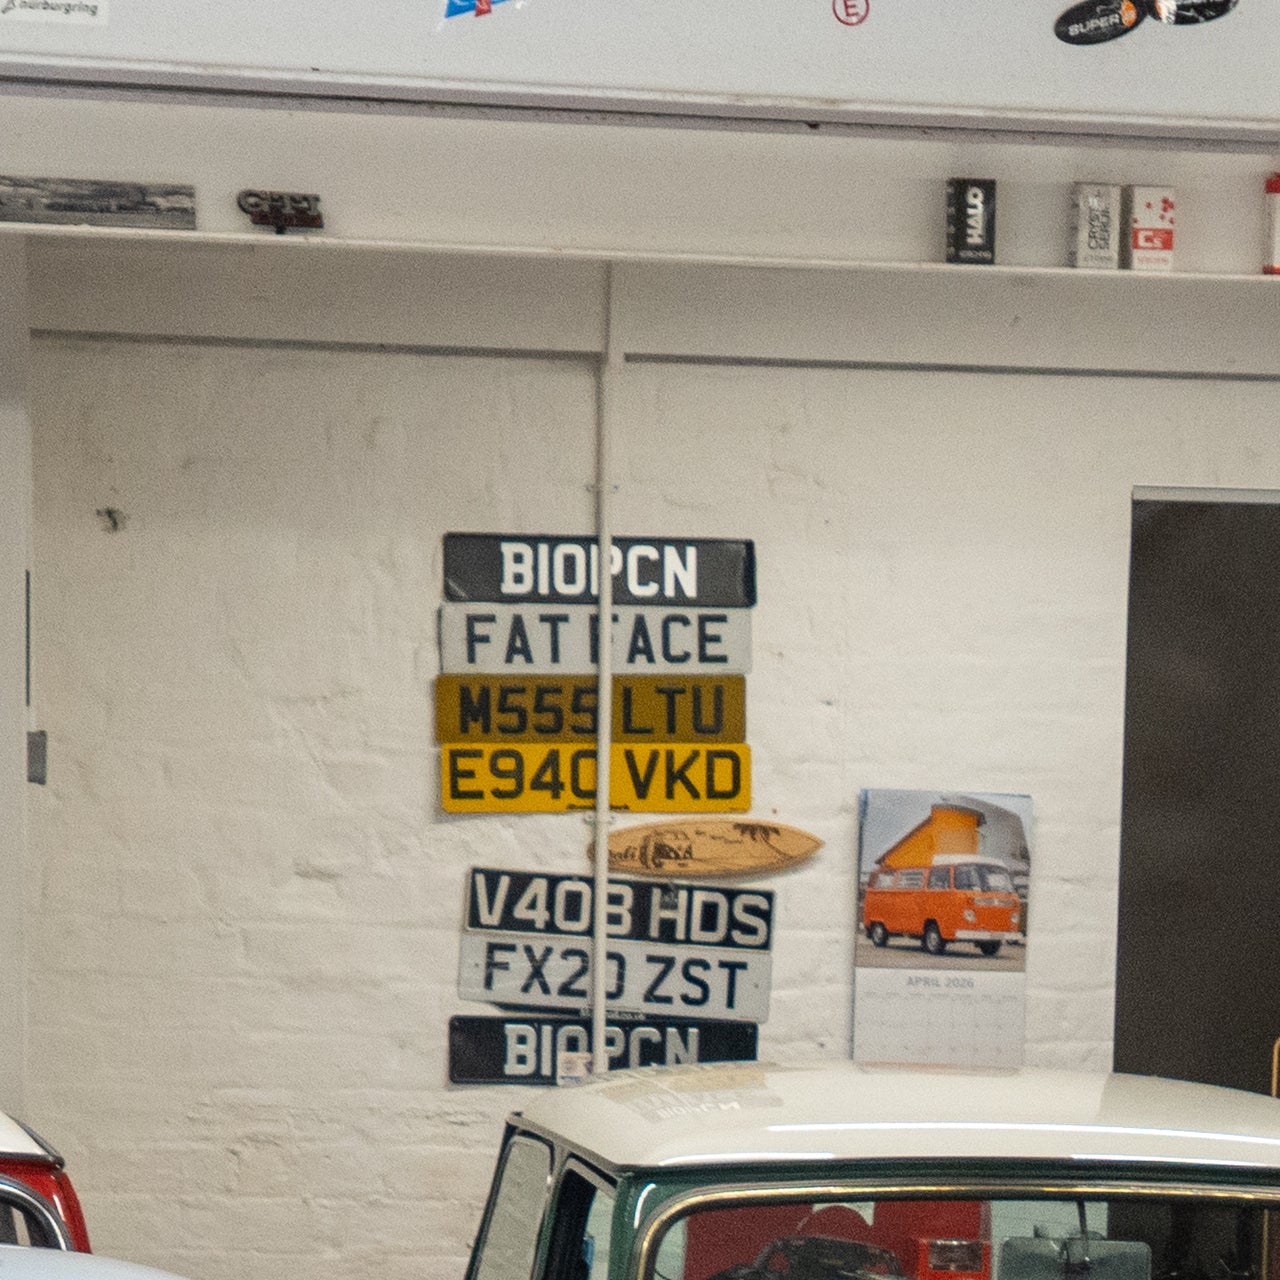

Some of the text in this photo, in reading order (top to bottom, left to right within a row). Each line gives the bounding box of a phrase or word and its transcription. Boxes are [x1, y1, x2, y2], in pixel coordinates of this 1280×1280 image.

[1068, 13, 1121, 37] SUPER
[966, 186, 985, 245] HALO
[466, 614, 569, 664] FAT
[622, 685, 724, 735] LTU
[624, 749, 741, 800] VKD
[648, 886, 770, 946] HDS
[643, 954, 749, 1010] ZST
